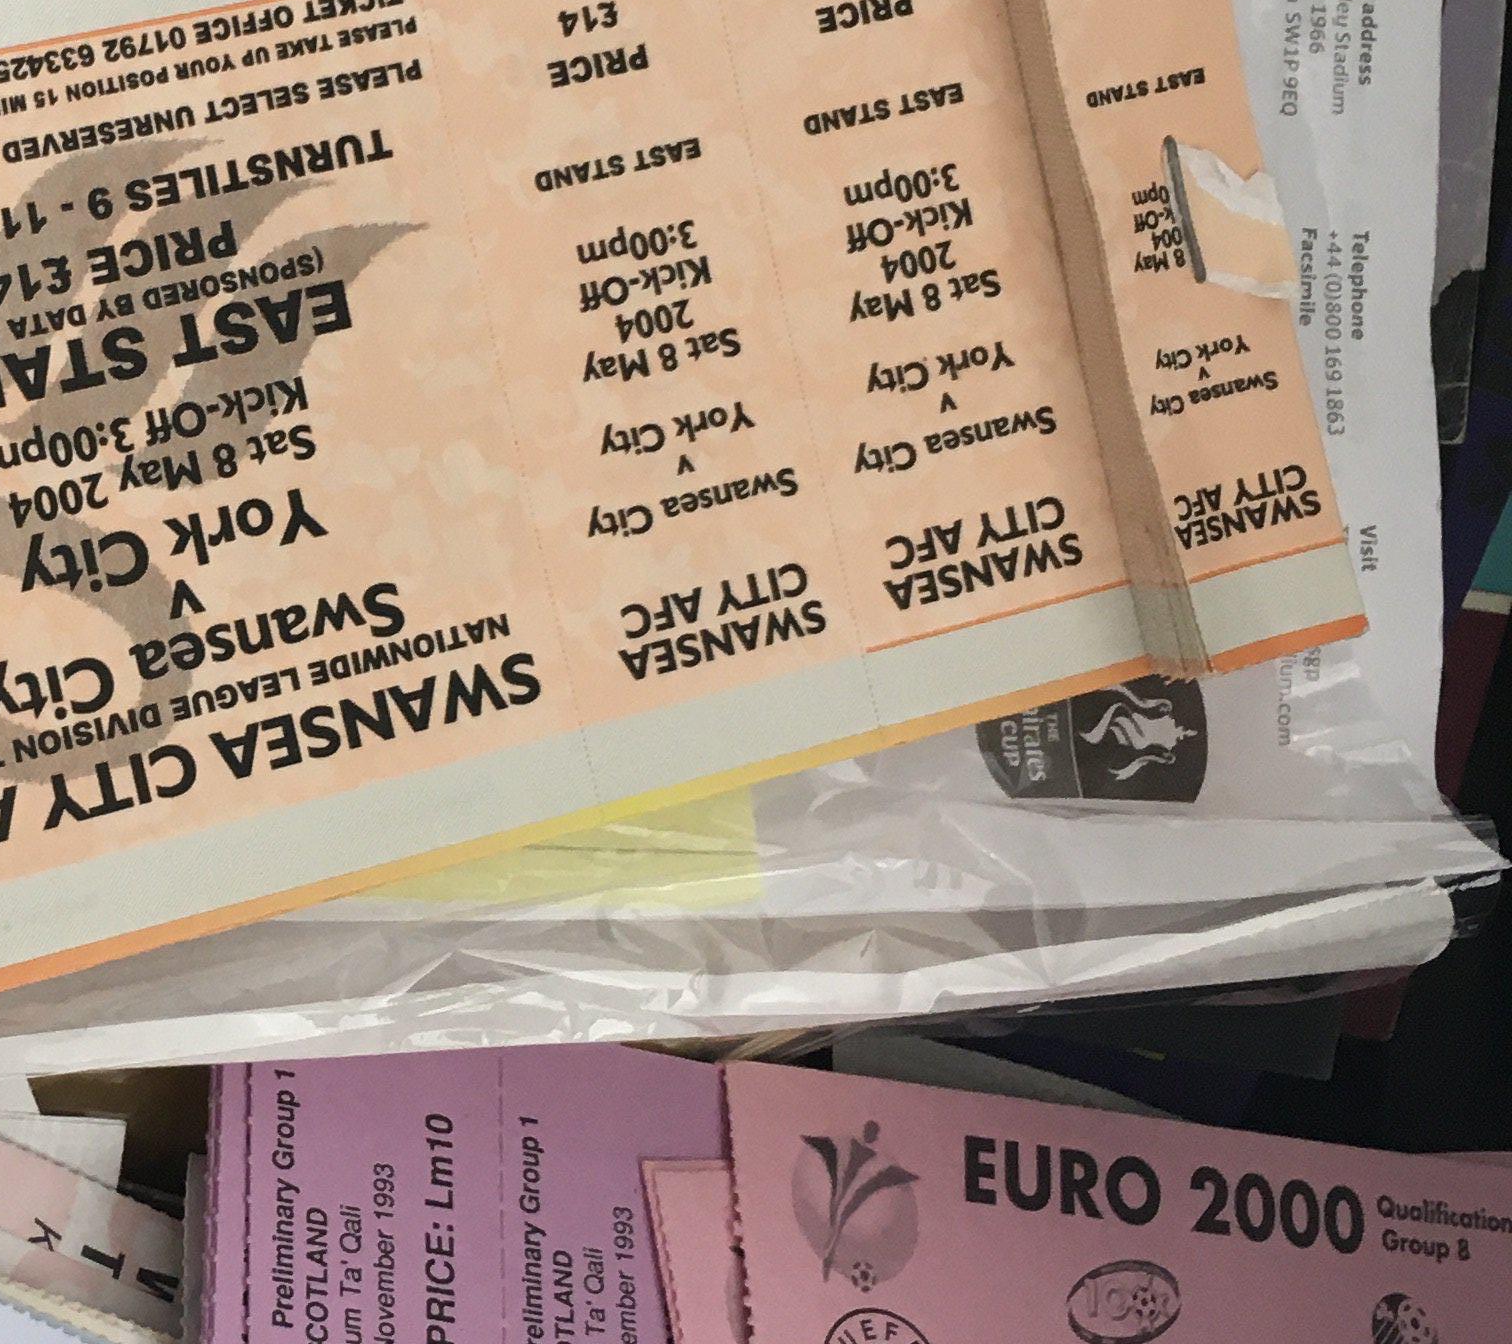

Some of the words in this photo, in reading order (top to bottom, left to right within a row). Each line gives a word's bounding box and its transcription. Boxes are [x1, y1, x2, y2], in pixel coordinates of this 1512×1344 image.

[103, 21, 187, 62] 01792
[195, 3, 296, 43] OFFICE
[557, 1, 619, 37] £14
[1359, 12, 1376, 86] address
[318, 59, 424, 101] PLEASE
[546, 43, 649, 88] PRICE
[1, 101, 195, 161] UNRESERVED
[205, 78, 312, 123] SELECT
[89, 184, 115, 222] 9
[122, 130, 394, 213] TURNSTILES
[89, 219, 238, 284] PRICE
[1347, 231, 1370, 340] Telephone
[174, 281, 354, 368] EAST
[143, 377, 310, 443] Kick-Off
[1173, 484, 1222, 523] AFC
[1235, 464, 1308, 504] CITY
[168, 488, 331, 567] York
[1173, 490, 1322, 552] SWANSEA
[1359, 525, 1378, 572] Visit
[19, 533, 150, 594] City
[136, 582, 407, 683] Swansea
[310, 612, 512, 685] NATIONWIDE
[617, 600, 827, 681] SWANSEA
[173, 667, 301, 724] LEAGUE
[214, 652, 545, 784] SWANSEA
[14, 703, 164, 762] DIVISION
[42, 742, 198, 833] CITY
[270, 1097, 301, 1172] Group
[424, 1112, 456, 1211] Lm10
[962, 1133, 1163, 1227] EURO
[1189, 1166, 1365, 1255] 2000
[270, 1182, 301, 1330] Preliminary
[1380, 1227, 1453, 1264] Group
